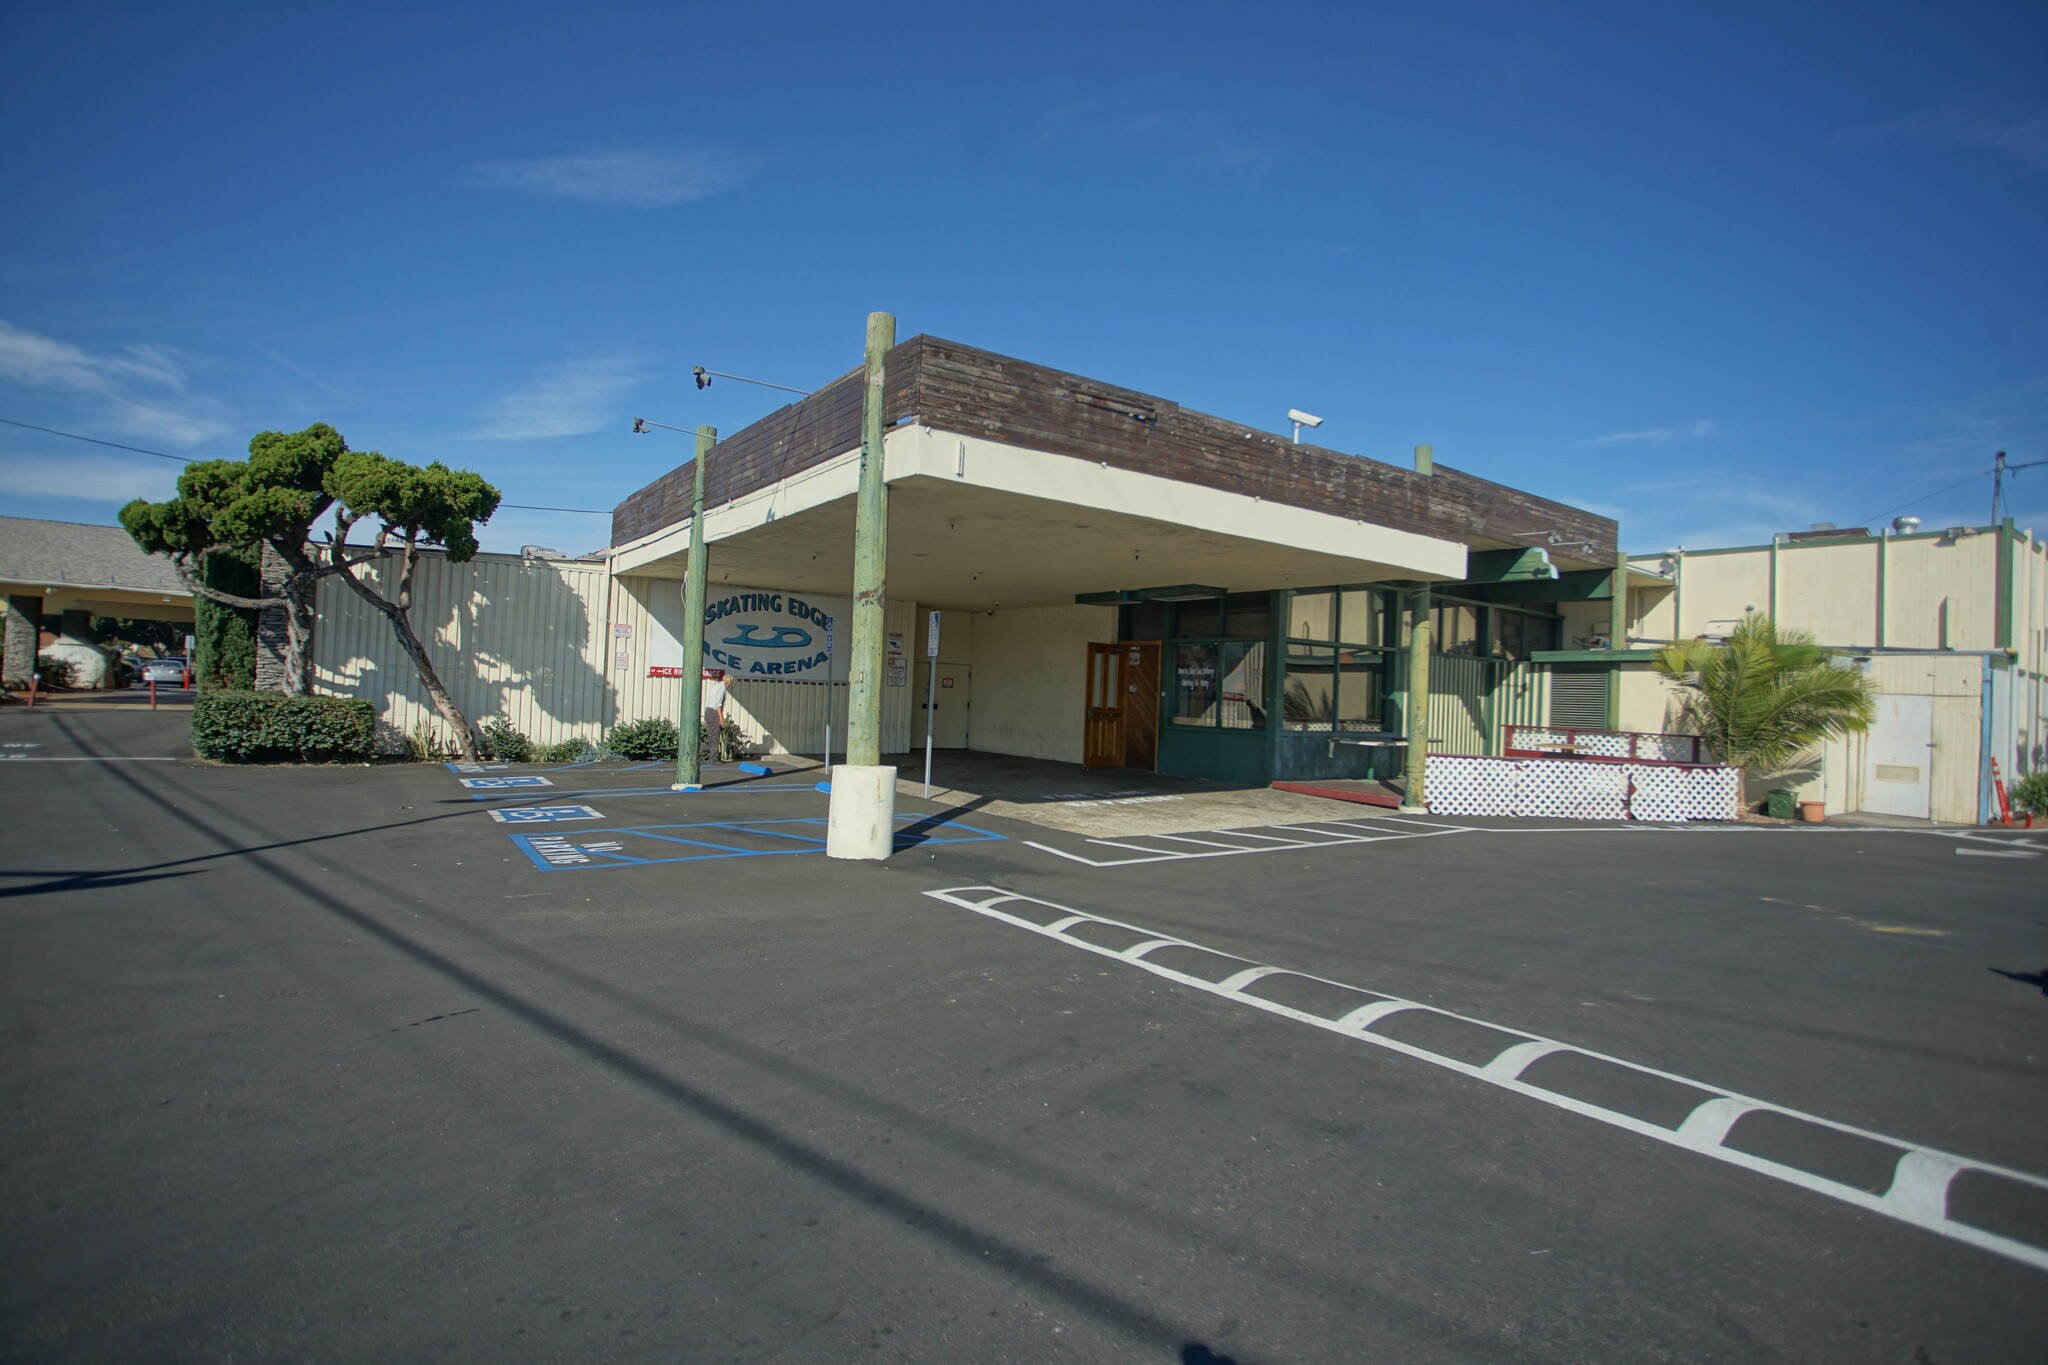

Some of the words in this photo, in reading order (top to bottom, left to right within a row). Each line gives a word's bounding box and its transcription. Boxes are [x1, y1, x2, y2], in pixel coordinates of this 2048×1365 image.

[705, 593, 782, 625] SKATING
[788, 597, 829, 632] EDGE
[703, 640, 741, 670] ICE
[749, 651, 828, 675] ARENA
[1098, 794, 1185, 806] PARKING
[527, 836, 591, 864] PARKING
[580, 841, 624, 852] NO
